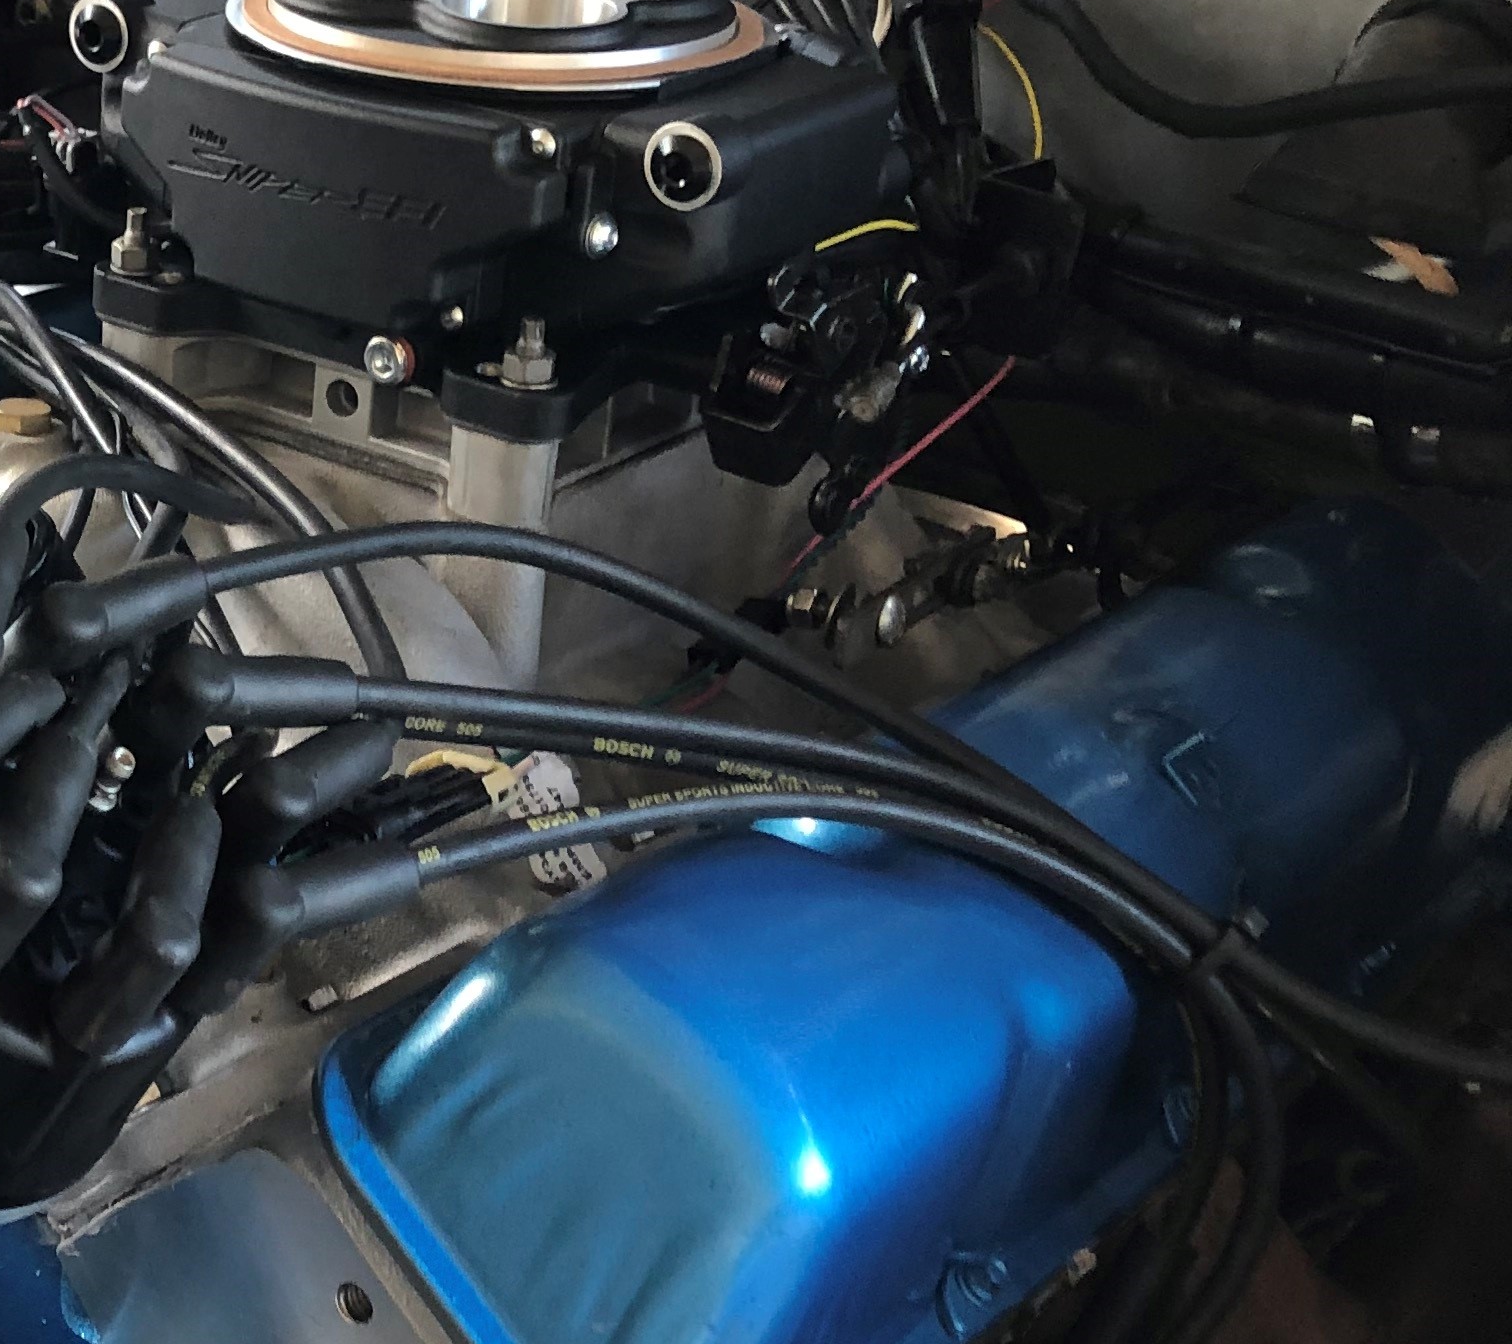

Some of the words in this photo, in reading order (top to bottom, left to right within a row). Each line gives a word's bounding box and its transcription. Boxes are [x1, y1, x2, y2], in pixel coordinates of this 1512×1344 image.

[593, 737, 655, 760] BOSCH
[526, 809, 579, 832] BOSCH
[627, 792, 672, 810] SUPER
